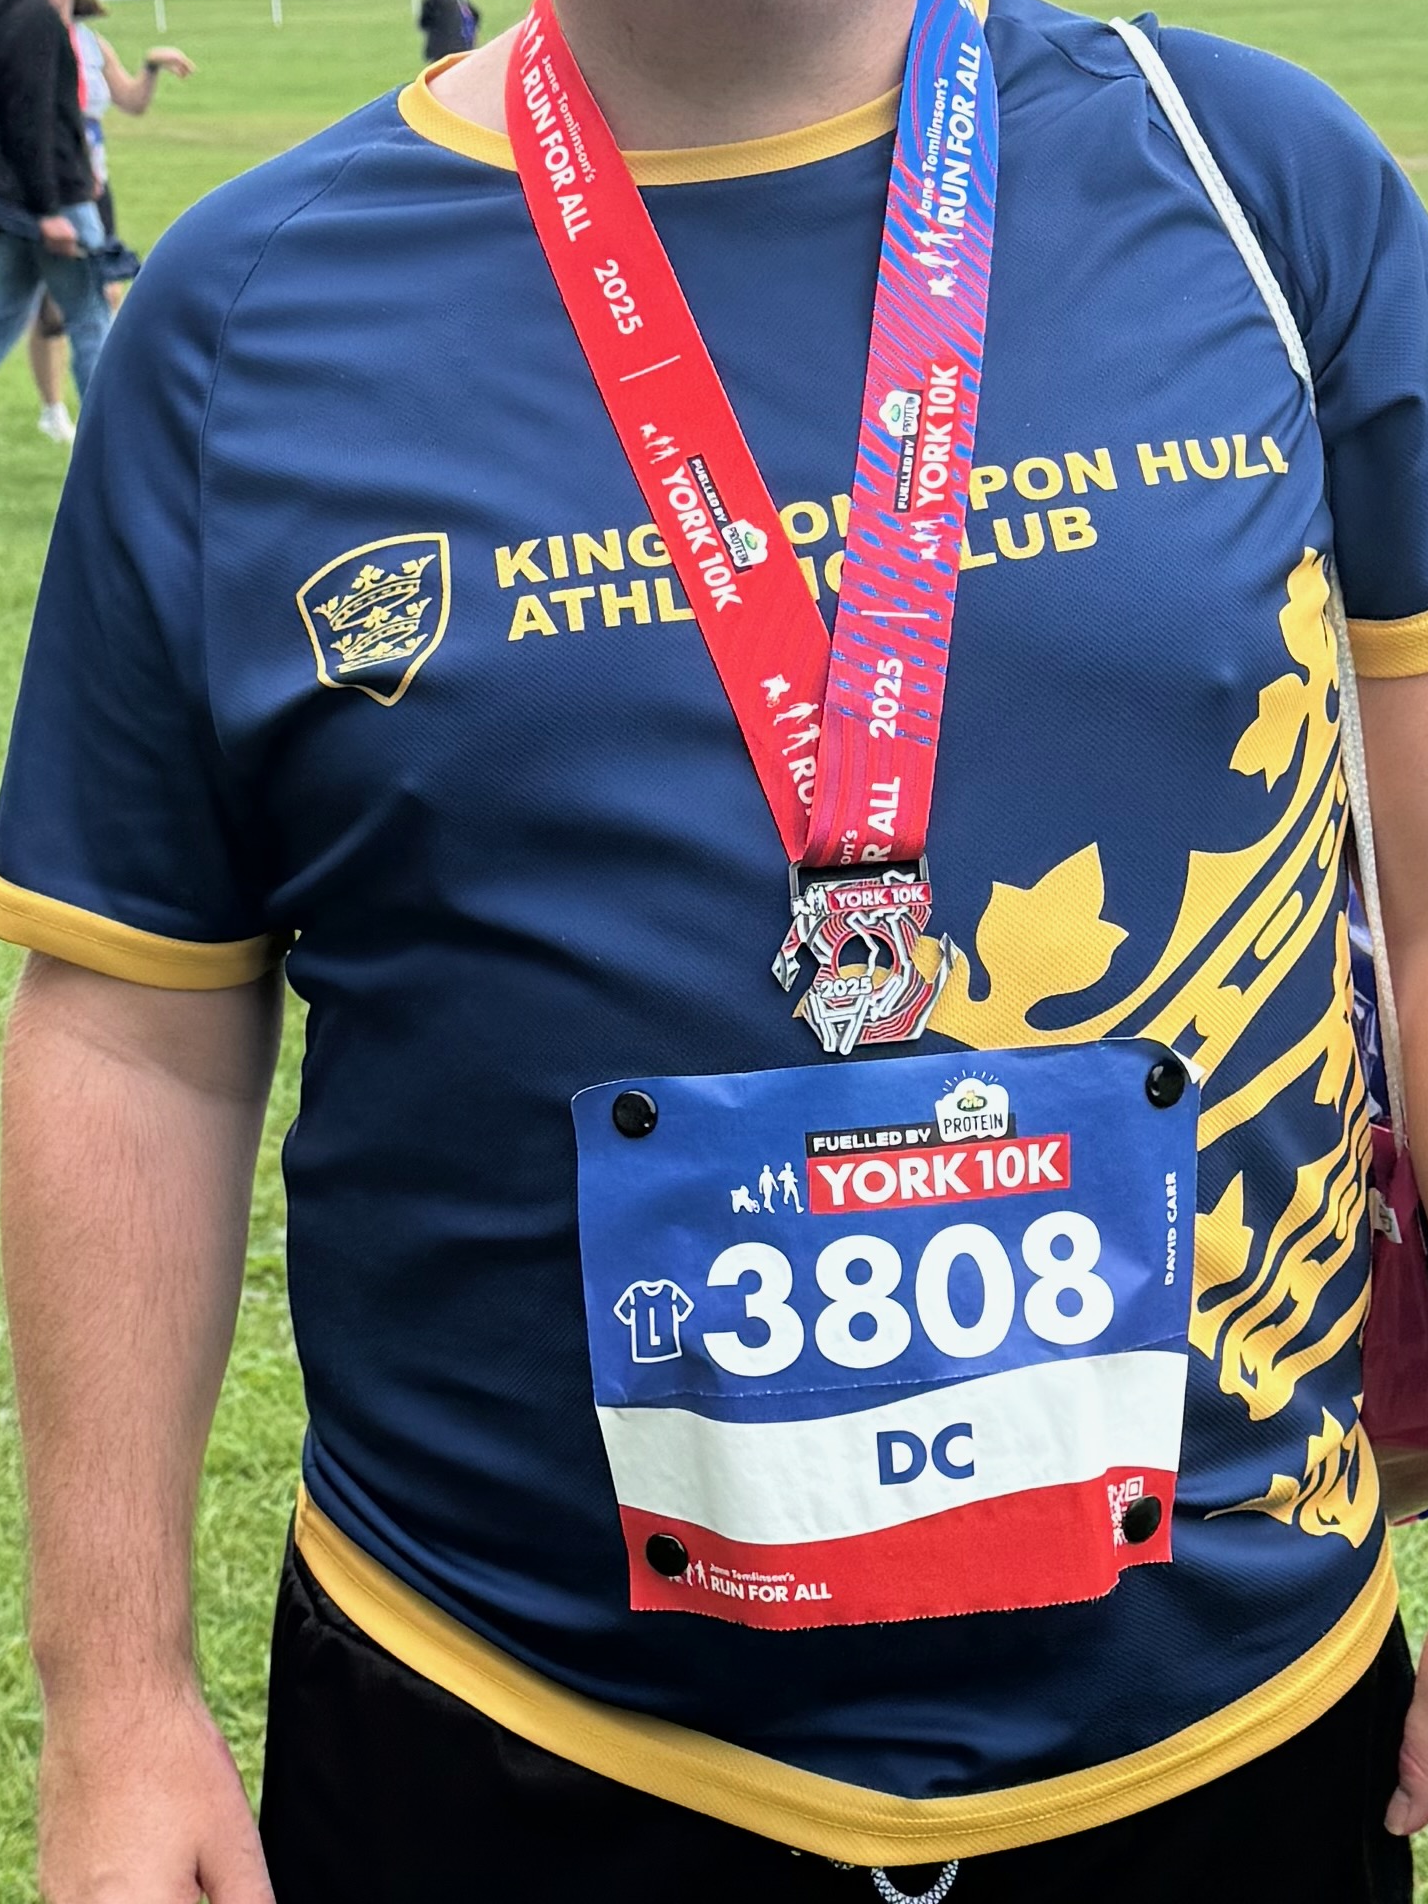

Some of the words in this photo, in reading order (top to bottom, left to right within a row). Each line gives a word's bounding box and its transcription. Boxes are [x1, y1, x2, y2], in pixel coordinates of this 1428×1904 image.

[522, 66, 557, 134] RUN
[955, 42, 981, 97] ALL
[541, 55, 560, 95] Jane
[557, 92, 596, 185] Tomlinson's
[922, 77, 949, 174] Tomlinson's
[946, 94, 976, 158] FOR
[540, 130, 577, 193] FOR
[937, 158, 970, 229] RUN
[557, 193, 592, 243] ALL
[916, 177, 936, 219] Jane
[594, 259, 644, 336] 2025
[927, 363, 959, 417] 10K
[916, 421, 953, 508] YORK
[495, 493, 853, 588] KINGO
[968, 447, 1118, 511] PON
[661, 465, 718, 554] YORK
[698, 552, 743, 613] 10K
[959, 506, 1098, 572] LUB
[869, 658, 903, 739] 2025
[788, 755, 817, 816] RU
[867, 776, 901, 836] ALL
[834, 890, 888, 909] YORK
[891, 886, 924, 903] 10K
[820, 976, 873, 998] 2025
[813, 1130, 902, 1152] FUELLED
[905, 1128, 931, 1144] BY
[943, 1112, 1004, 1135] PROTEIN
[816, 1151, 972, 1206] YORK
[974, 1141, 1064, 1191] 10K
[1165, 1171, 1178, 1223] CARR
[1164, 1227, 1177, 1286] DAVID
[702, 1210, 1116, 1377] 3808
[876, 1422, 976, 1486] DC
[710, 1575, 745, 1601] RUN
[747, 1584, 789, 1603] FOR
[794, 1582, 833, 1601] ALL
